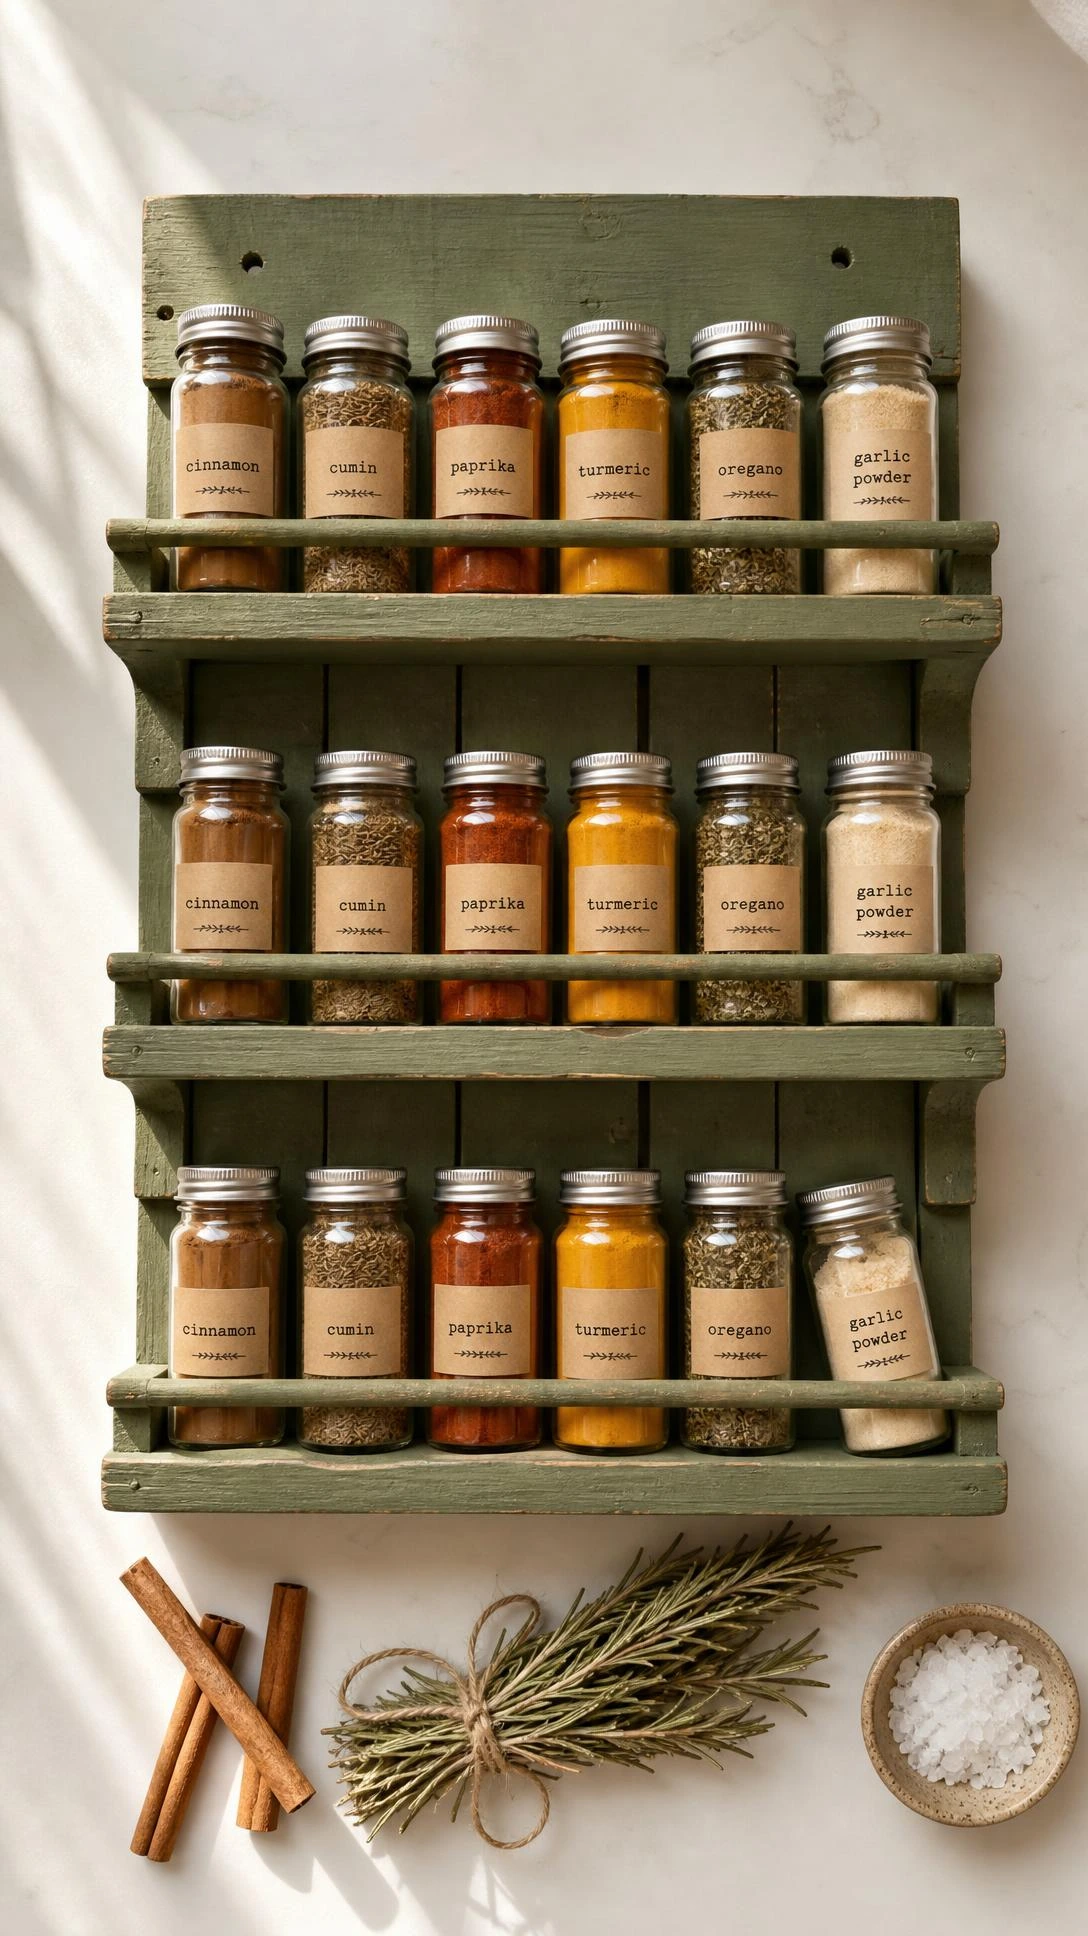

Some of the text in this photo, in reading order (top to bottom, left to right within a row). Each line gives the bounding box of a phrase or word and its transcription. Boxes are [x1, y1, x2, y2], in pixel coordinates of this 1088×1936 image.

[185, 456, 260, 473] cinnamon
[853, 449, 911, 468] garlic
[329, 460, 378, 475] cumin
[449, 458, 516, 477] paprika
[578, 462, 651, 479] turmeric
[717, 464, 783, 478] oregano
[852, 468, 912, 489] powder
[856, 883, 913, 902] garlic
[183, 896, 260, 911] cinnamon
[338, 898, 387, 912] cumin
[460, 896, 526, 913] paprika
[586, 897, 658, 911] turmeric
[720, 896, 785, 914] oregano
[855, 902, 915, 923] powder
[327, 1322, 375, 1336] cumin
[848, 1308, 904, 1333] garlic
[182, 1322, 257, 1337] cinnamon
[448, 1321, 513, 1338] paprika
[574, 1322, 647, 1337] turmeric
[707, 1325, 772, 1340] oregano
[851, 1328, 908, 1353] powder
